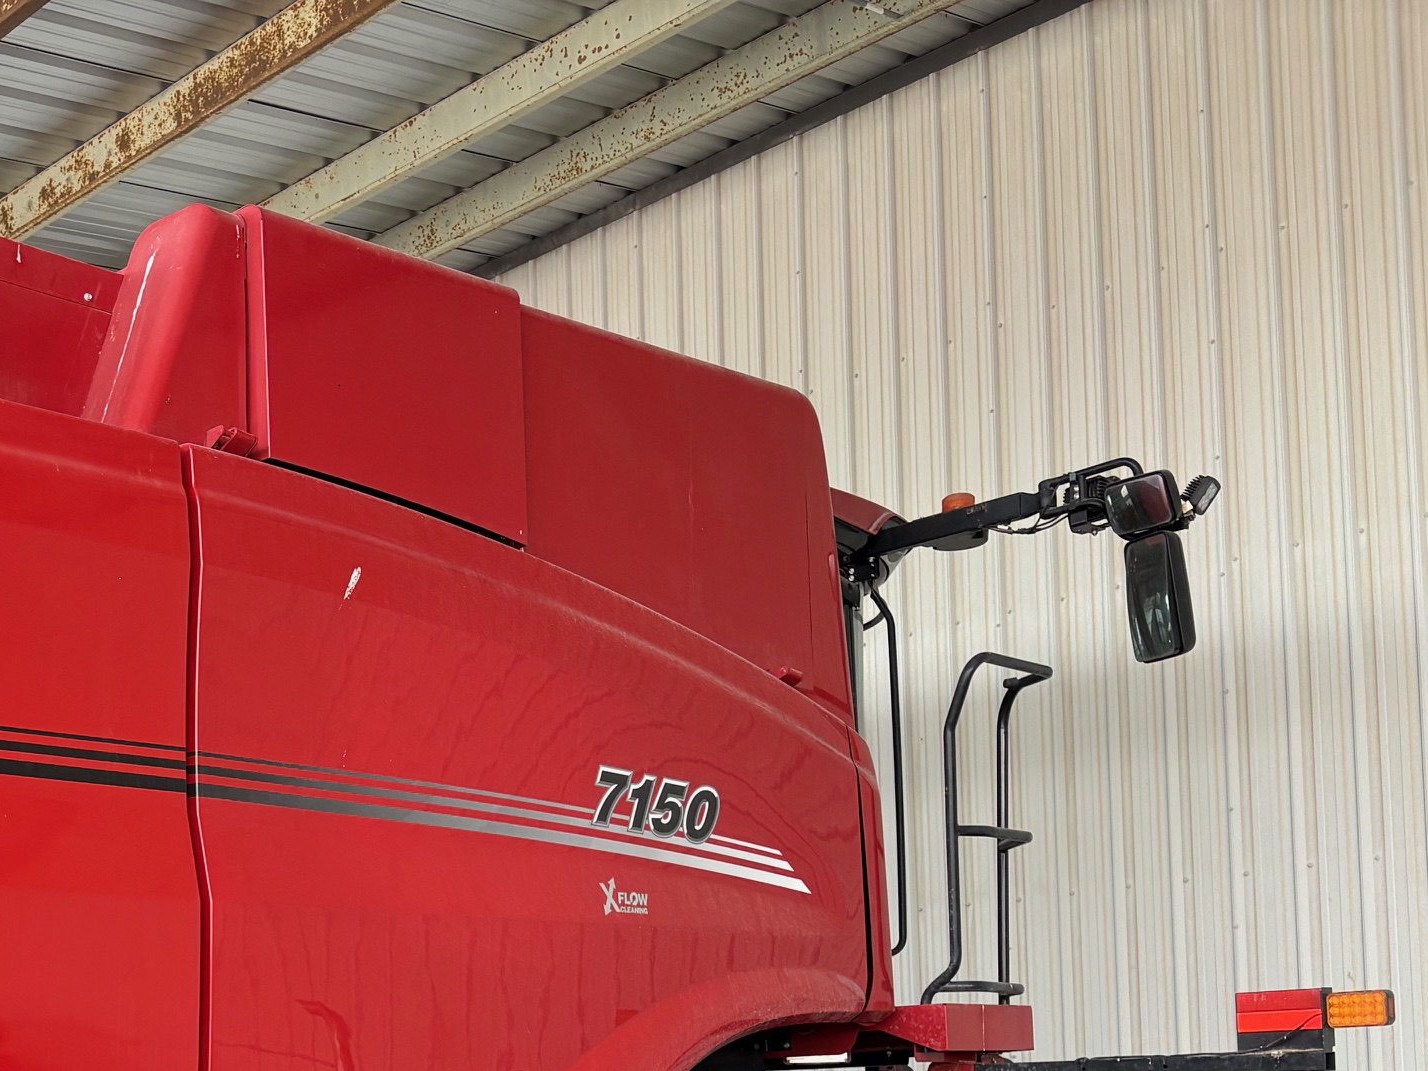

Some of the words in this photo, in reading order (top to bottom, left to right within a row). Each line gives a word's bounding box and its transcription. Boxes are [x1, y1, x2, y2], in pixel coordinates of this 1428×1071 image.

[590, 764, 721, 845] 7150
[617, 891, 649, 906] FLOW
[619, 905, 649, 915] CLEANING
